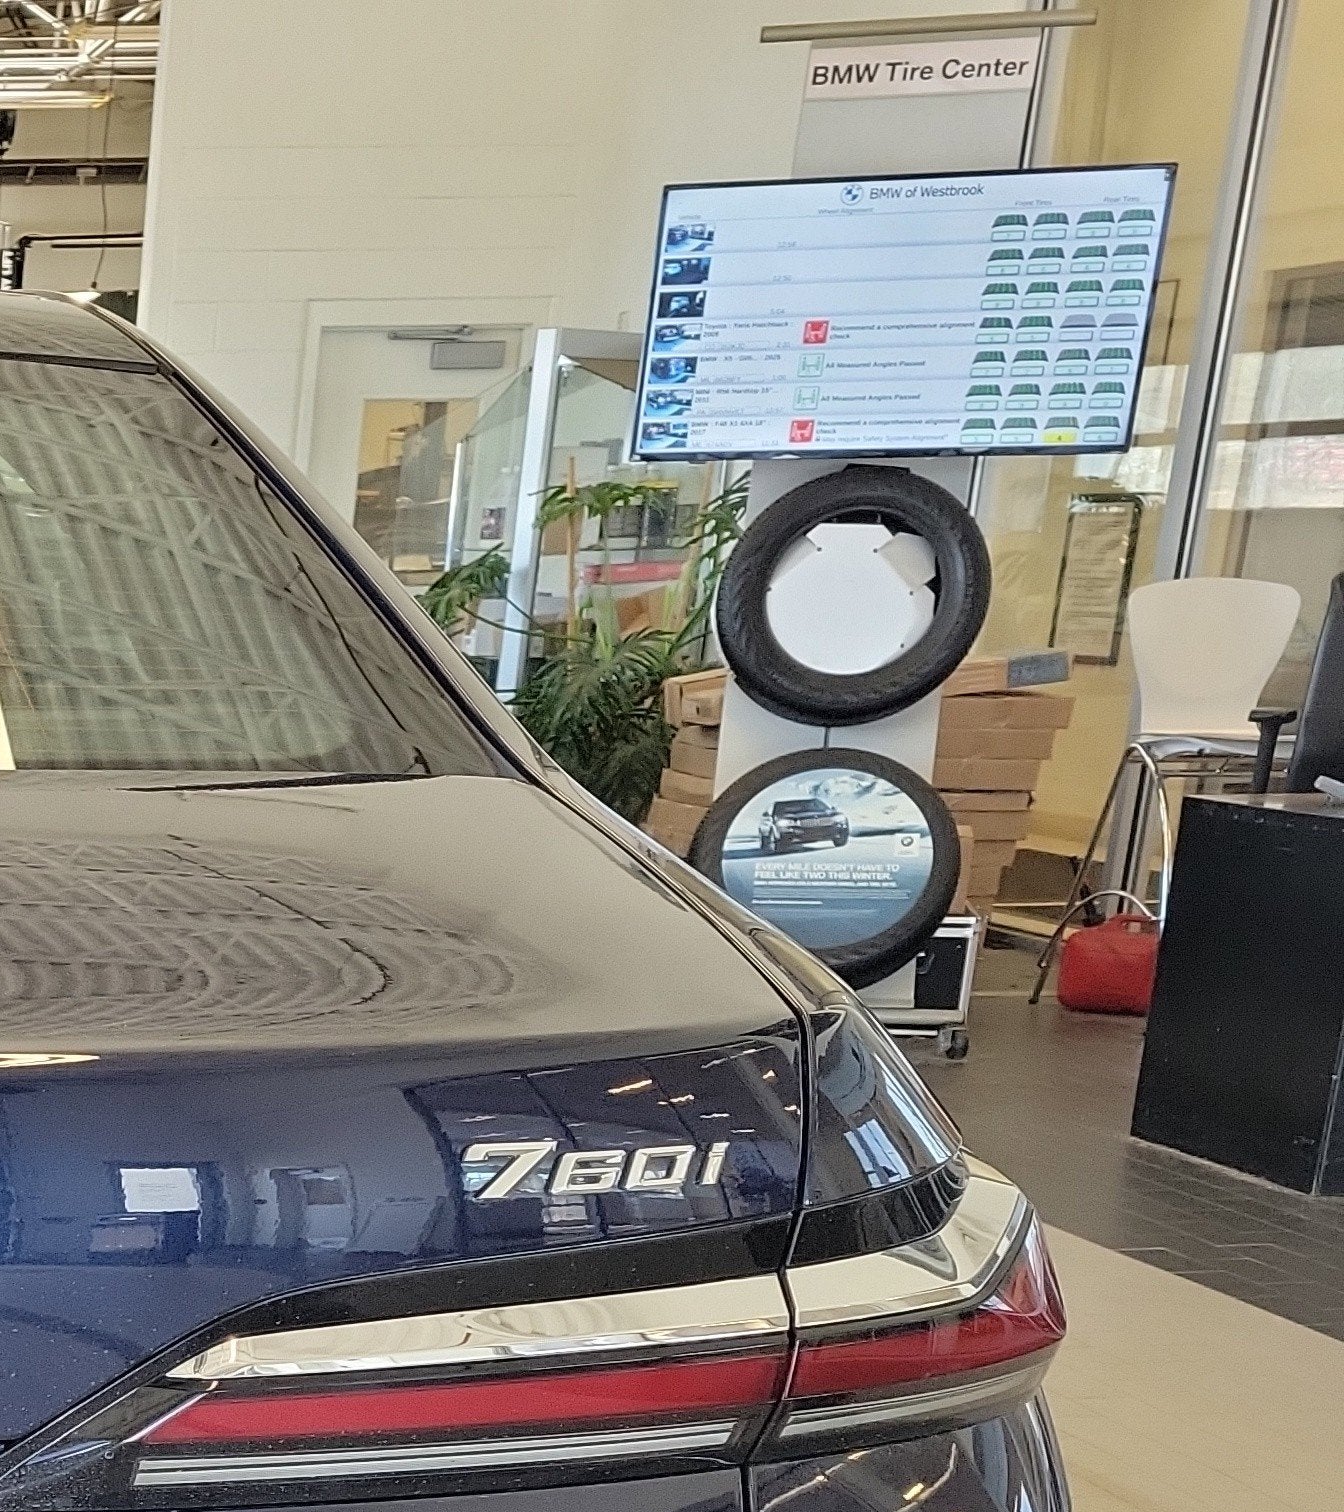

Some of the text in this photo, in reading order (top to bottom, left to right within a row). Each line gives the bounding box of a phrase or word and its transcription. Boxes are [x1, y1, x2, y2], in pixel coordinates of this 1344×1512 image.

[812, 58, 1029, 86] BMW Tire Center
[869, 183, 984, 200] BMW of Westbrook
[886, 864, 900, 872] TO
[803, 871, 826, 879] TWO
